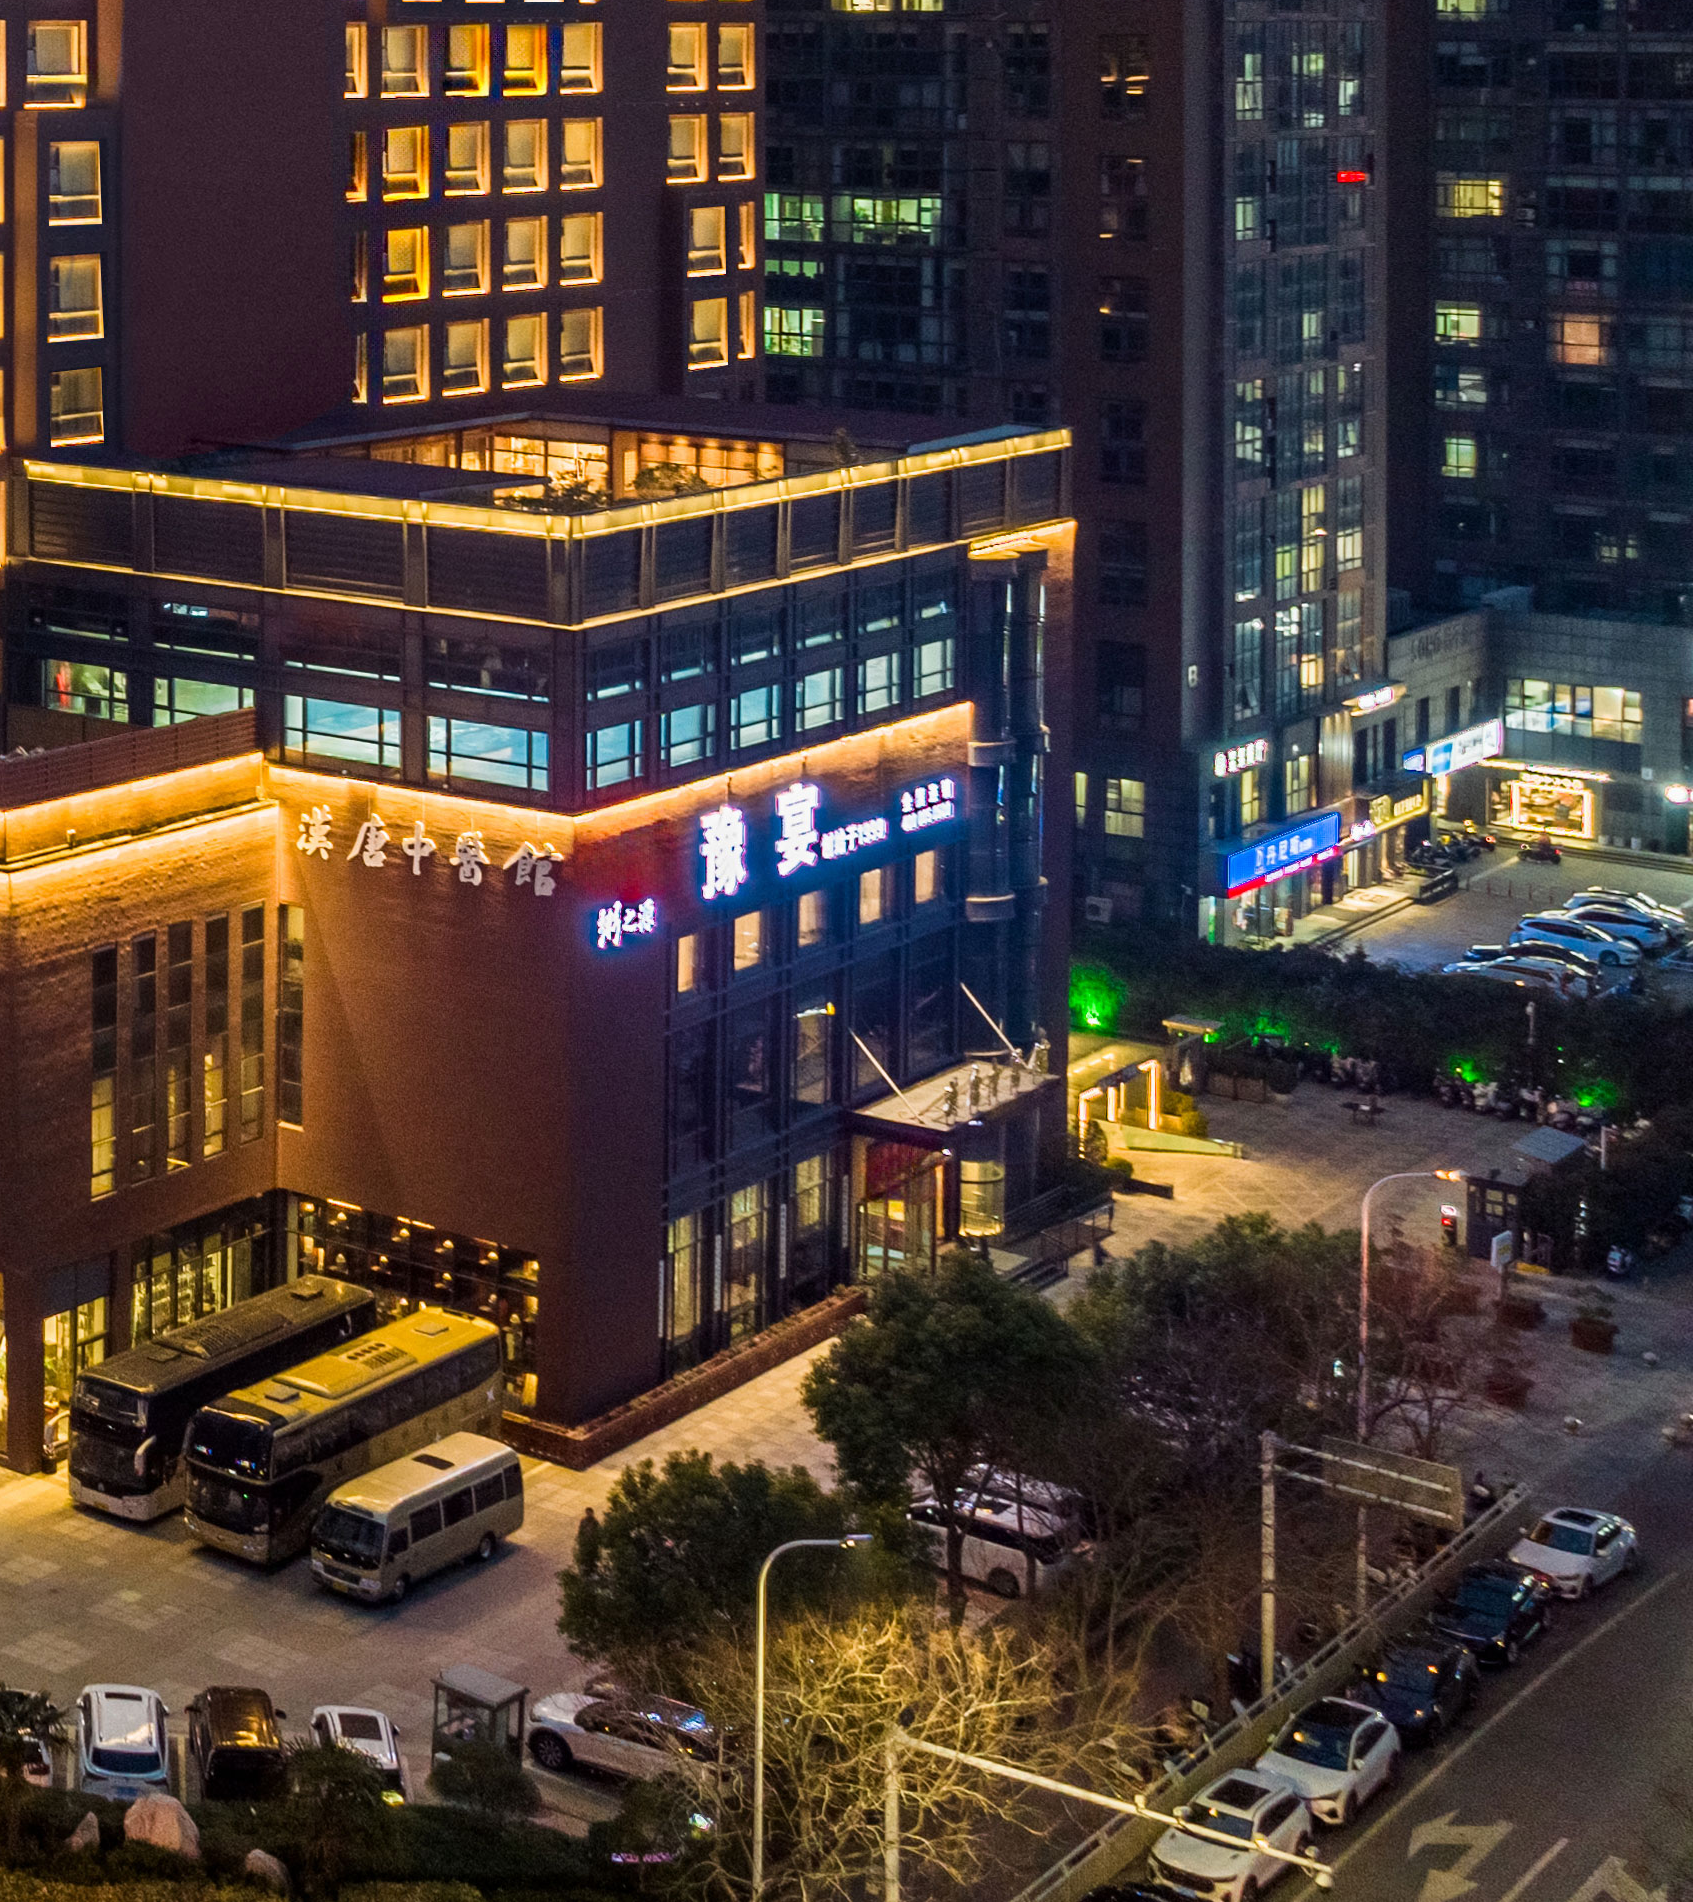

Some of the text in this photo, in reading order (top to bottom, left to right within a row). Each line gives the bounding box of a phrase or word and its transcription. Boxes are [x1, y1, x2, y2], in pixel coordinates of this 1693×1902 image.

[295, 804, 565, 896] 漢唐中醫館
[700, 782, 820, 901] 豫宴
